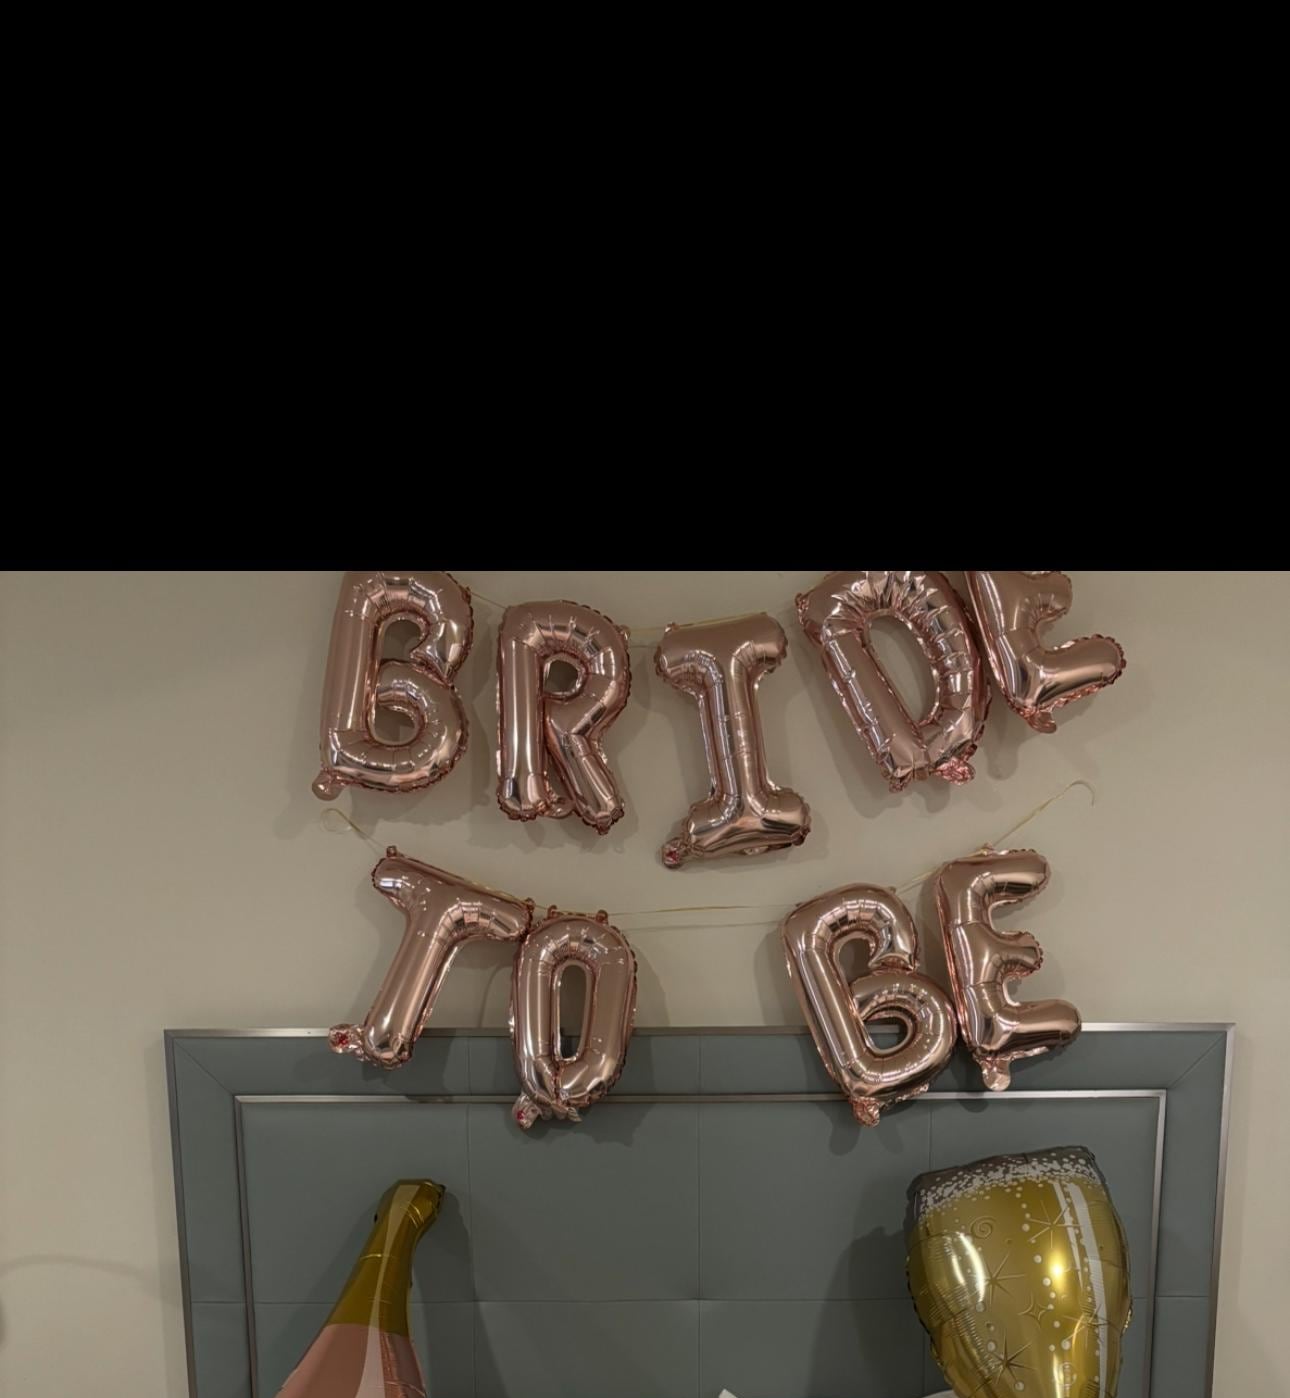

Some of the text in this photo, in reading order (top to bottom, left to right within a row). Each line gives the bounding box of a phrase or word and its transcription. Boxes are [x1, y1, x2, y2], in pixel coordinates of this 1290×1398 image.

[313, 571, 1127, 867] BRIDE
[331, 847, 1083, 1128] TO BE
